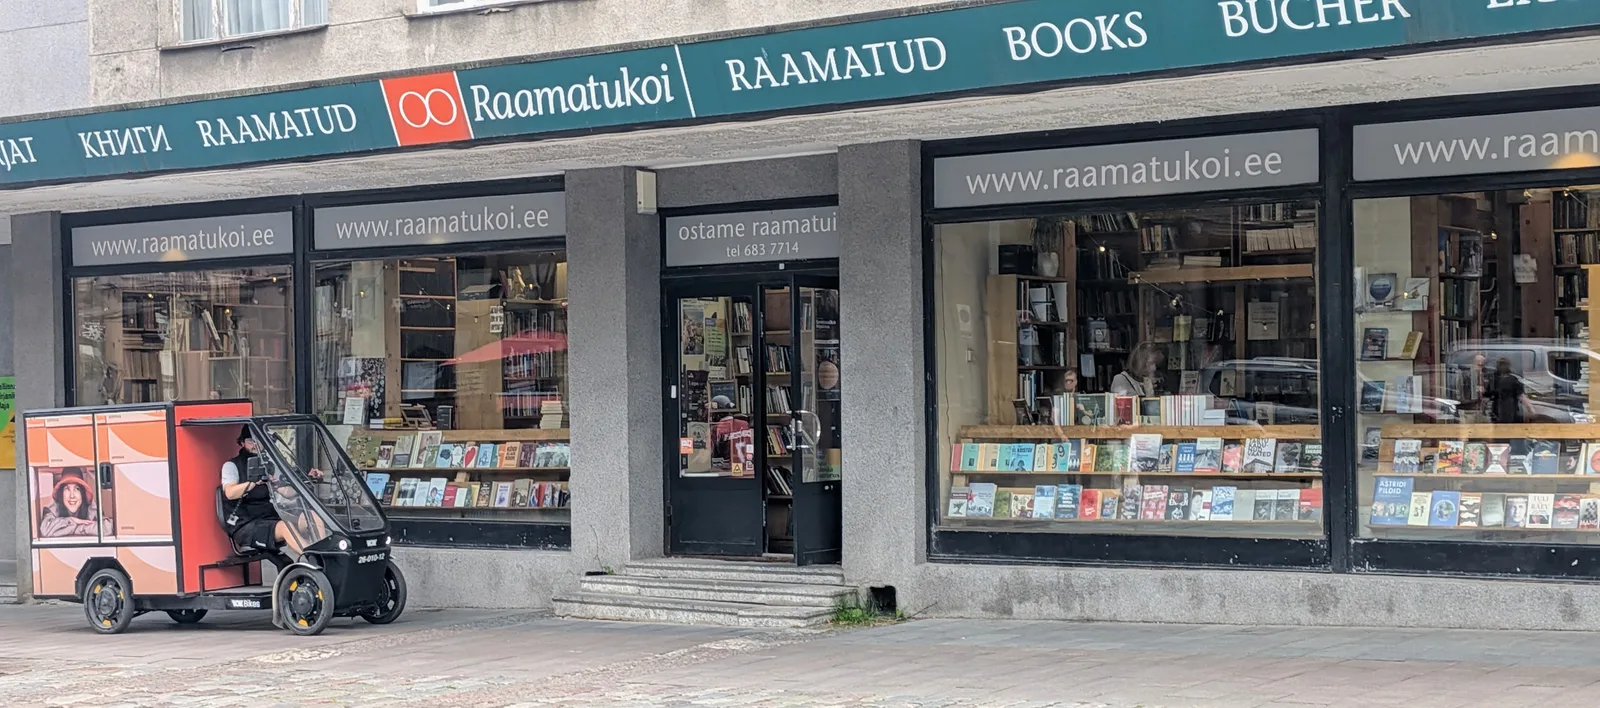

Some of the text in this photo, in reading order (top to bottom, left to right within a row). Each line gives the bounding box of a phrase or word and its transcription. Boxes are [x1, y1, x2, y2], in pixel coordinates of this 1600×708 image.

[1003, 11, 1148, 61] BOOKS
[725, 37, 946, 91] RAAMATUD
[470, 63, 674, 122] Raamatukoi
[79, 124, 172, 158] КНИГИ
[195, 103, 357, 148] RAAMATUD
[0, 136, 37, 171] JAT
[966, 149, 1282, 195] www.raamatukoi.ee
[336, 205, 549, 240] www.raamatukoi.ee
[678, 221, 745, 241] ostame
[92, 225, 274, 256] www.raamatukoi.ee
[726, 241, 799, 257] tel 683 7714
[1378, 487, 1402, 495] PILDID
[1379, 480, 1407, 488] ASTRIDI
